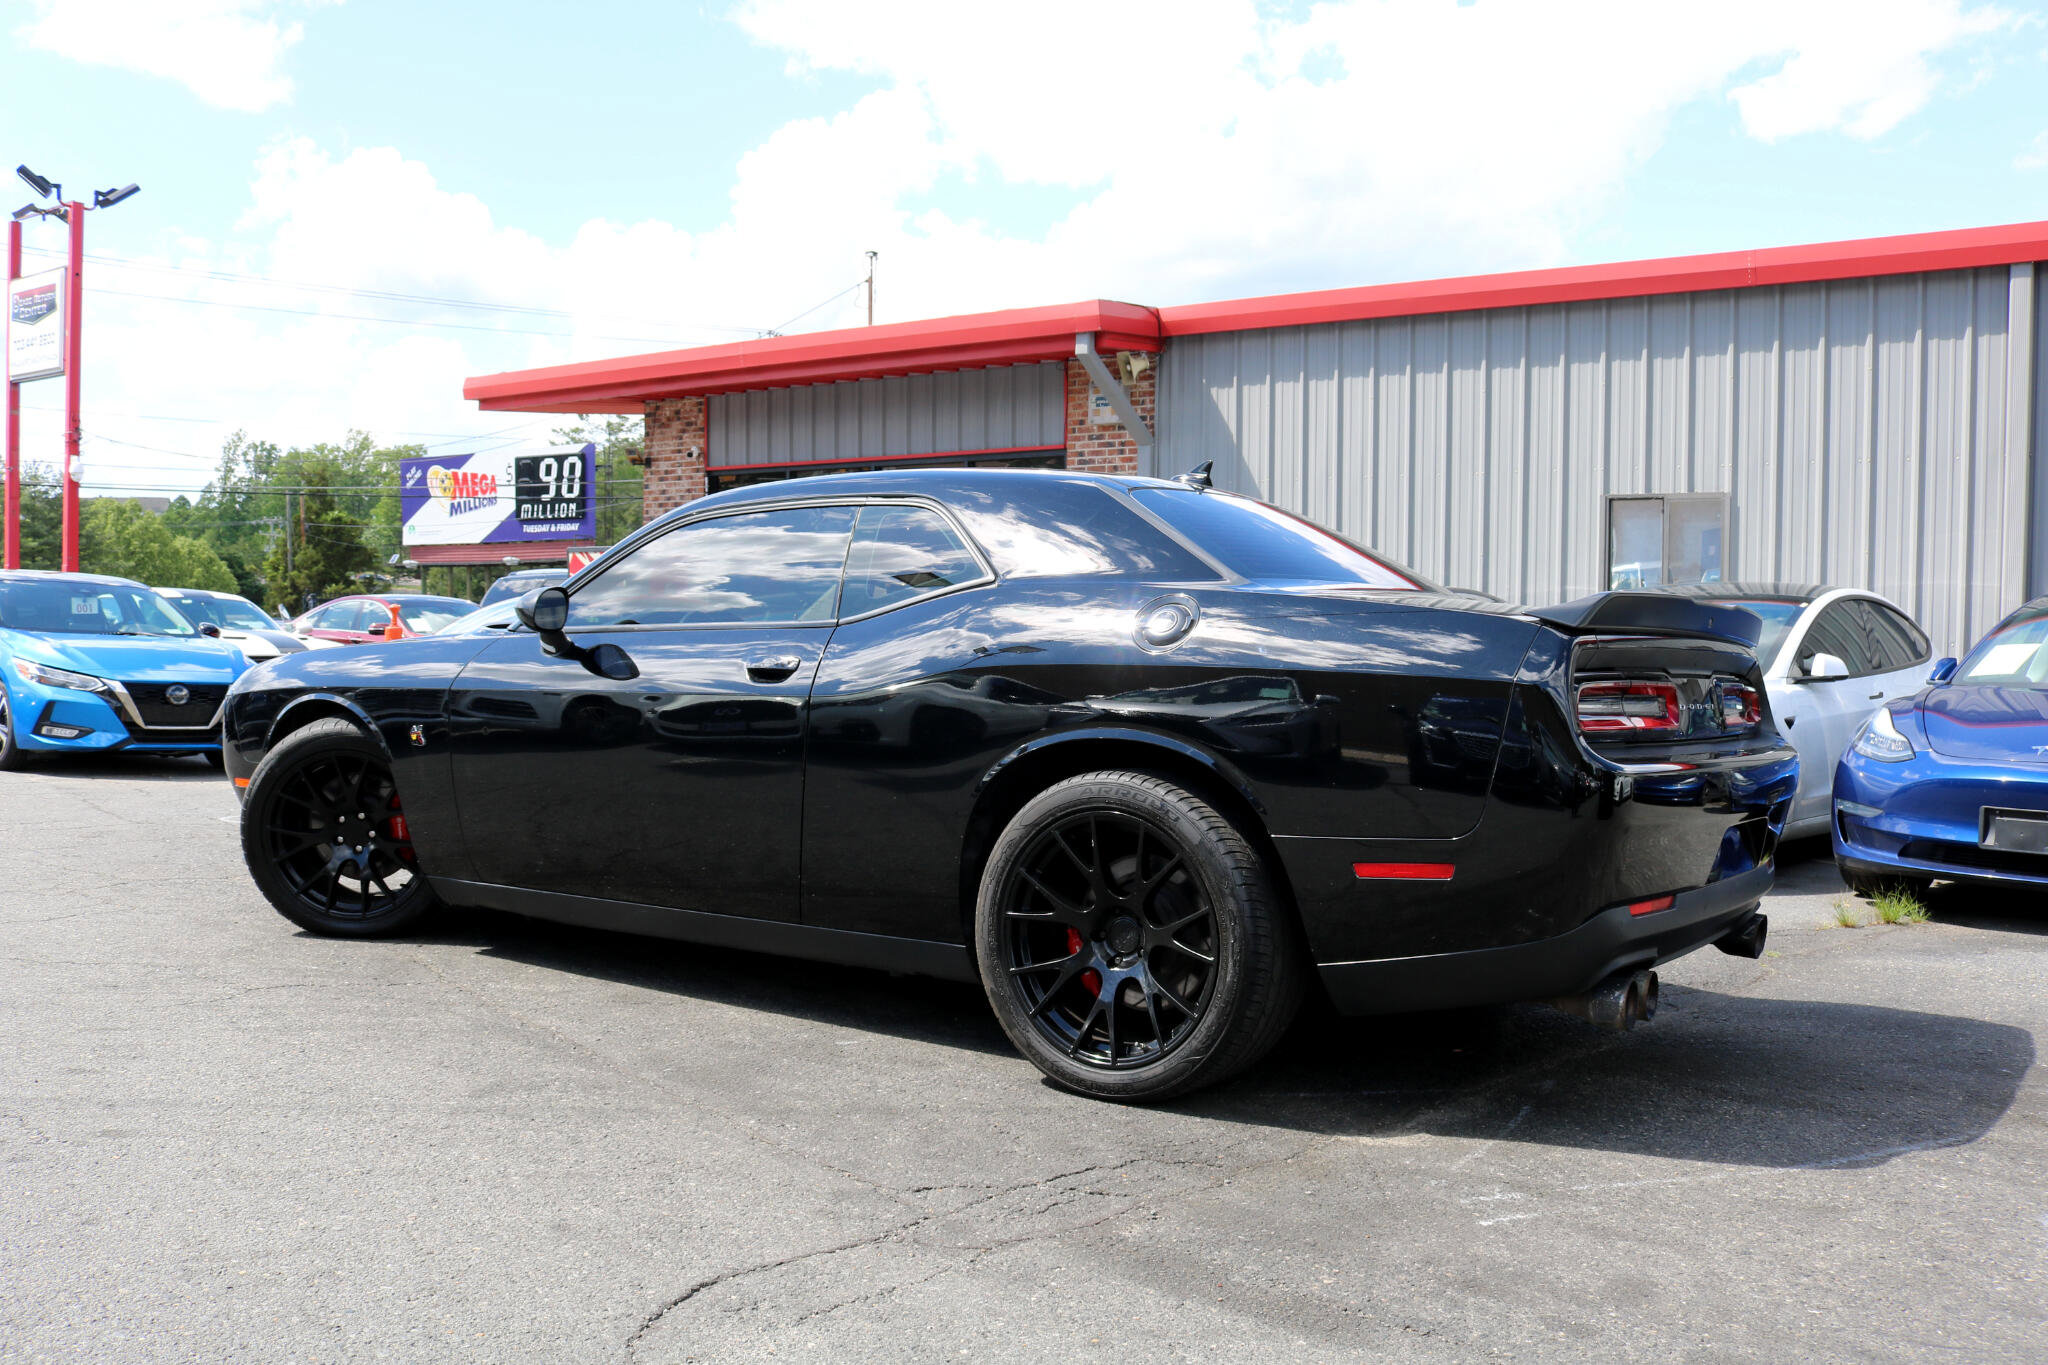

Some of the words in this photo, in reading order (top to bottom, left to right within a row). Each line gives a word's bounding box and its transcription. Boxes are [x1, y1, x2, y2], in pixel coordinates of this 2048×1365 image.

[451, 471, 497, 500] MEGA
[539, 456, 582, 501] 90
[450, 496, 498, 518] MILLIONS
[521, 503, 577, 519] MILLION
[523, 524, 550, 533] TUESDAY
[556, 522, 580, 532] FRIDAY
[76, 603, 93, 613] 001
